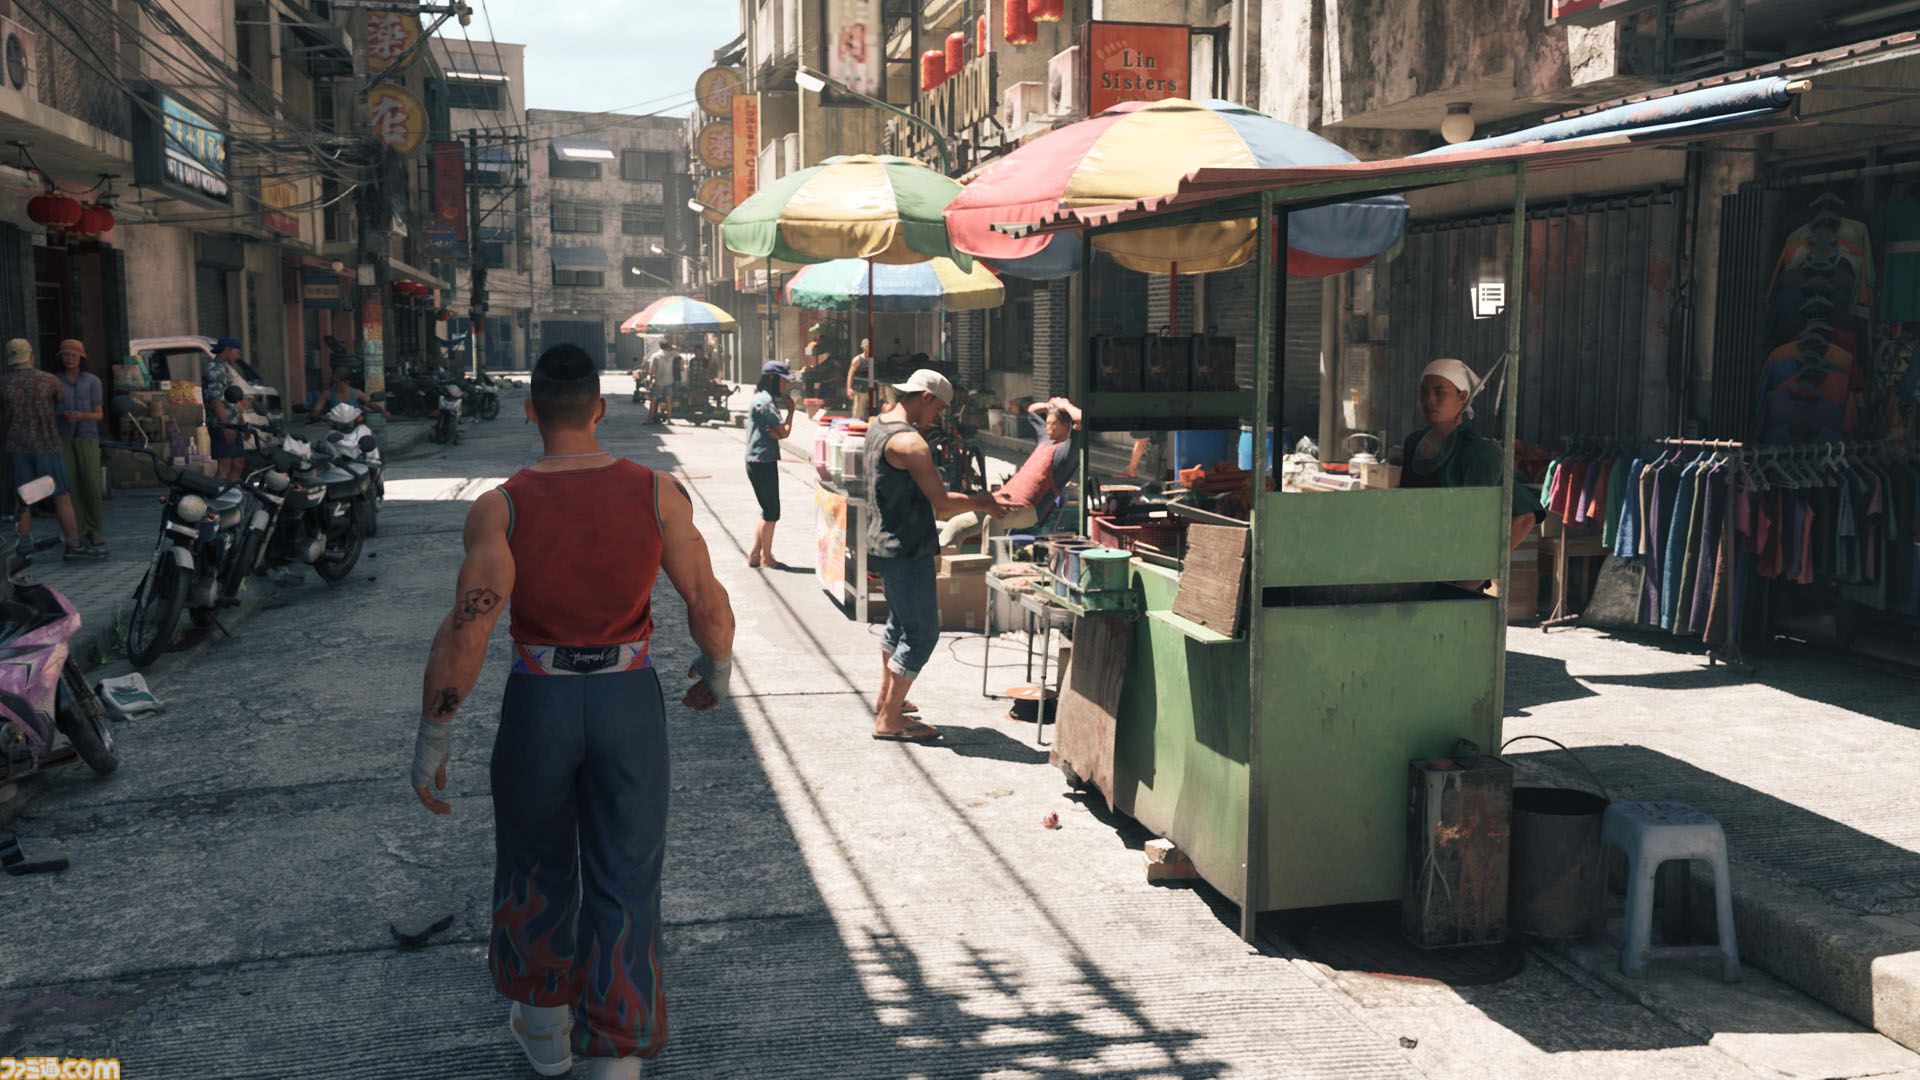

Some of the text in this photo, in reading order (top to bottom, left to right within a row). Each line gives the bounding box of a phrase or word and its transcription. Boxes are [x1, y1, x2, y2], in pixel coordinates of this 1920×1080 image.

[1122, 50, 1157, 69] Lin
[1101, 72, 1178, 92] Sisters
[913, 78, 950, 153] LUCKY
[954, 55, 990, 132] MOON
